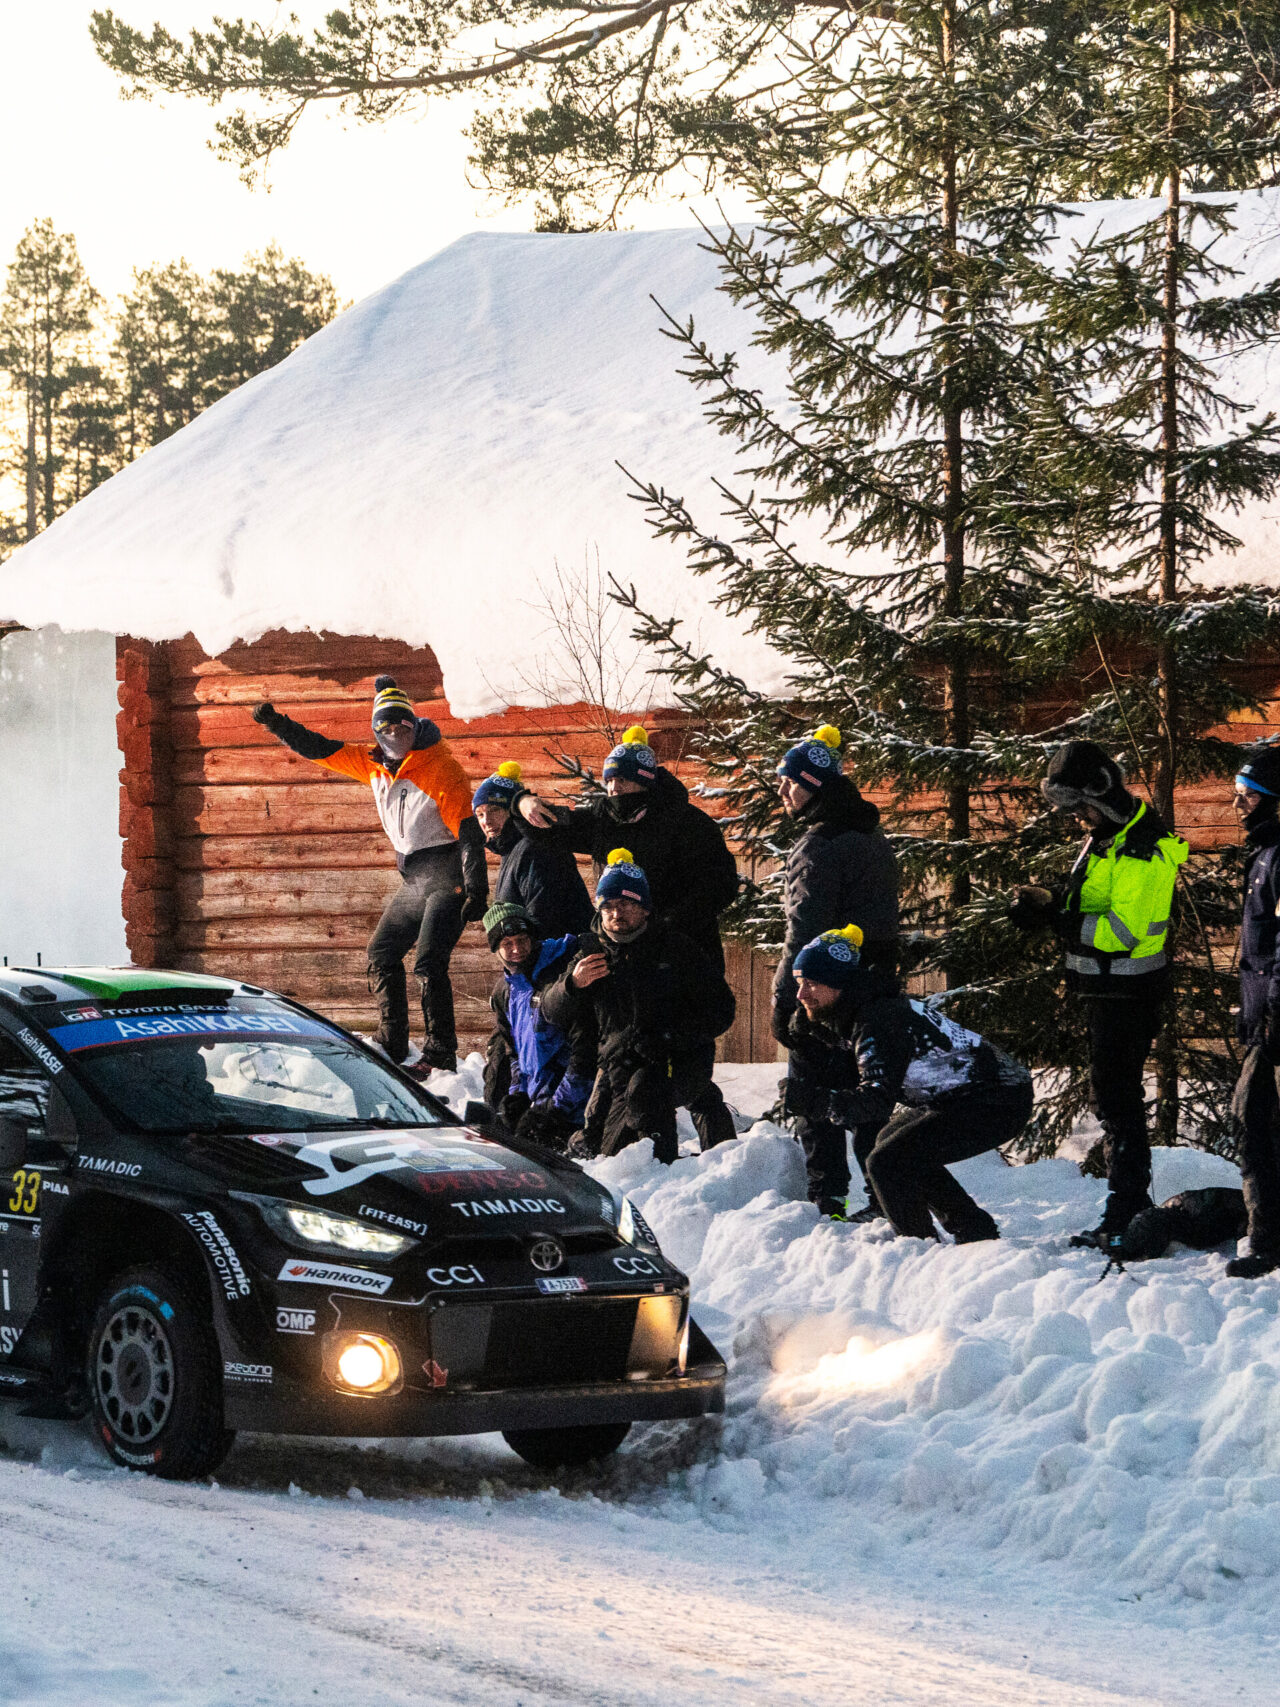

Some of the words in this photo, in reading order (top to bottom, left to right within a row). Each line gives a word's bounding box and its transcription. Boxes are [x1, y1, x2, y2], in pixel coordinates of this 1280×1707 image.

[103, 1005, 176, 1016] TOYOTA
[115, 1014, 302, 1038] AsahiKASEI
[17, 1027, 64, 1075] AsahiKASEI
[77, 1155, 143, 1177] TAMADIC
[9, 1170, 42, 1214] 33
[42, 1180, 69, 1195] PIAA
[451, 1199, 566, 1217] TAMADIC
[181, 1212, 239, 1300] AUTOMOTIVE
[197, 1211, 251, 1296] Panasonic
[426, 1264, 485, 1286] CCi
[613, 1256, 662, 1275] CCi
[276, 1312, 316, 1330] OMP
